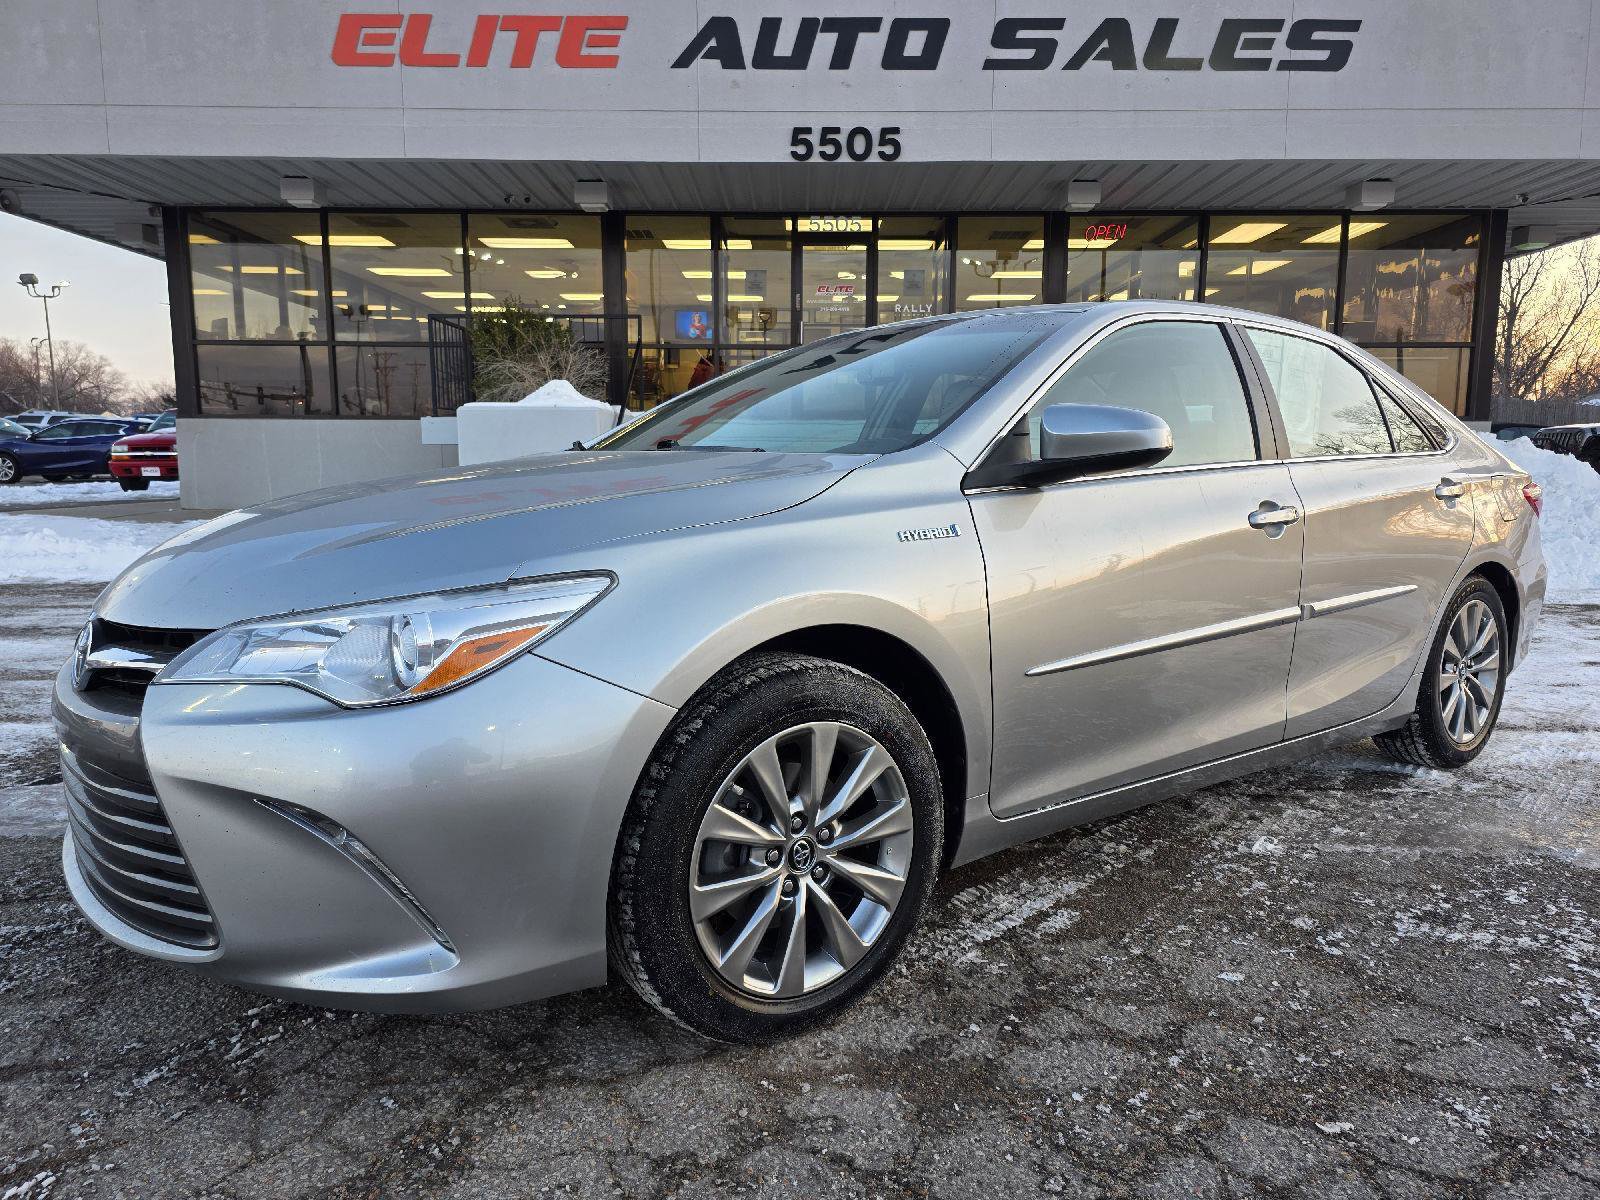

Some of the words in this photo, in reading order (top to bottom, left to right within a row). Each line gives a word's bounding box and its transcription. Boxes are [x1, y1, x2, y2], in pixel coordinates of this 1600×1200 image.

[331, 14, 629, 69] ELITE
[670, 16, 951, 71] AUTO
[982, 18, 1363, 72] SALES
[790, 126, 902, 162] 5505
[808, 216, 862, 233] 5505
[1085, 224, 1127, 241] OPEN
[816, 285, 855, 294] ELITE
[894, 303, 933, 313] RALLY
[897, 526, 955, 542] HYBRID
